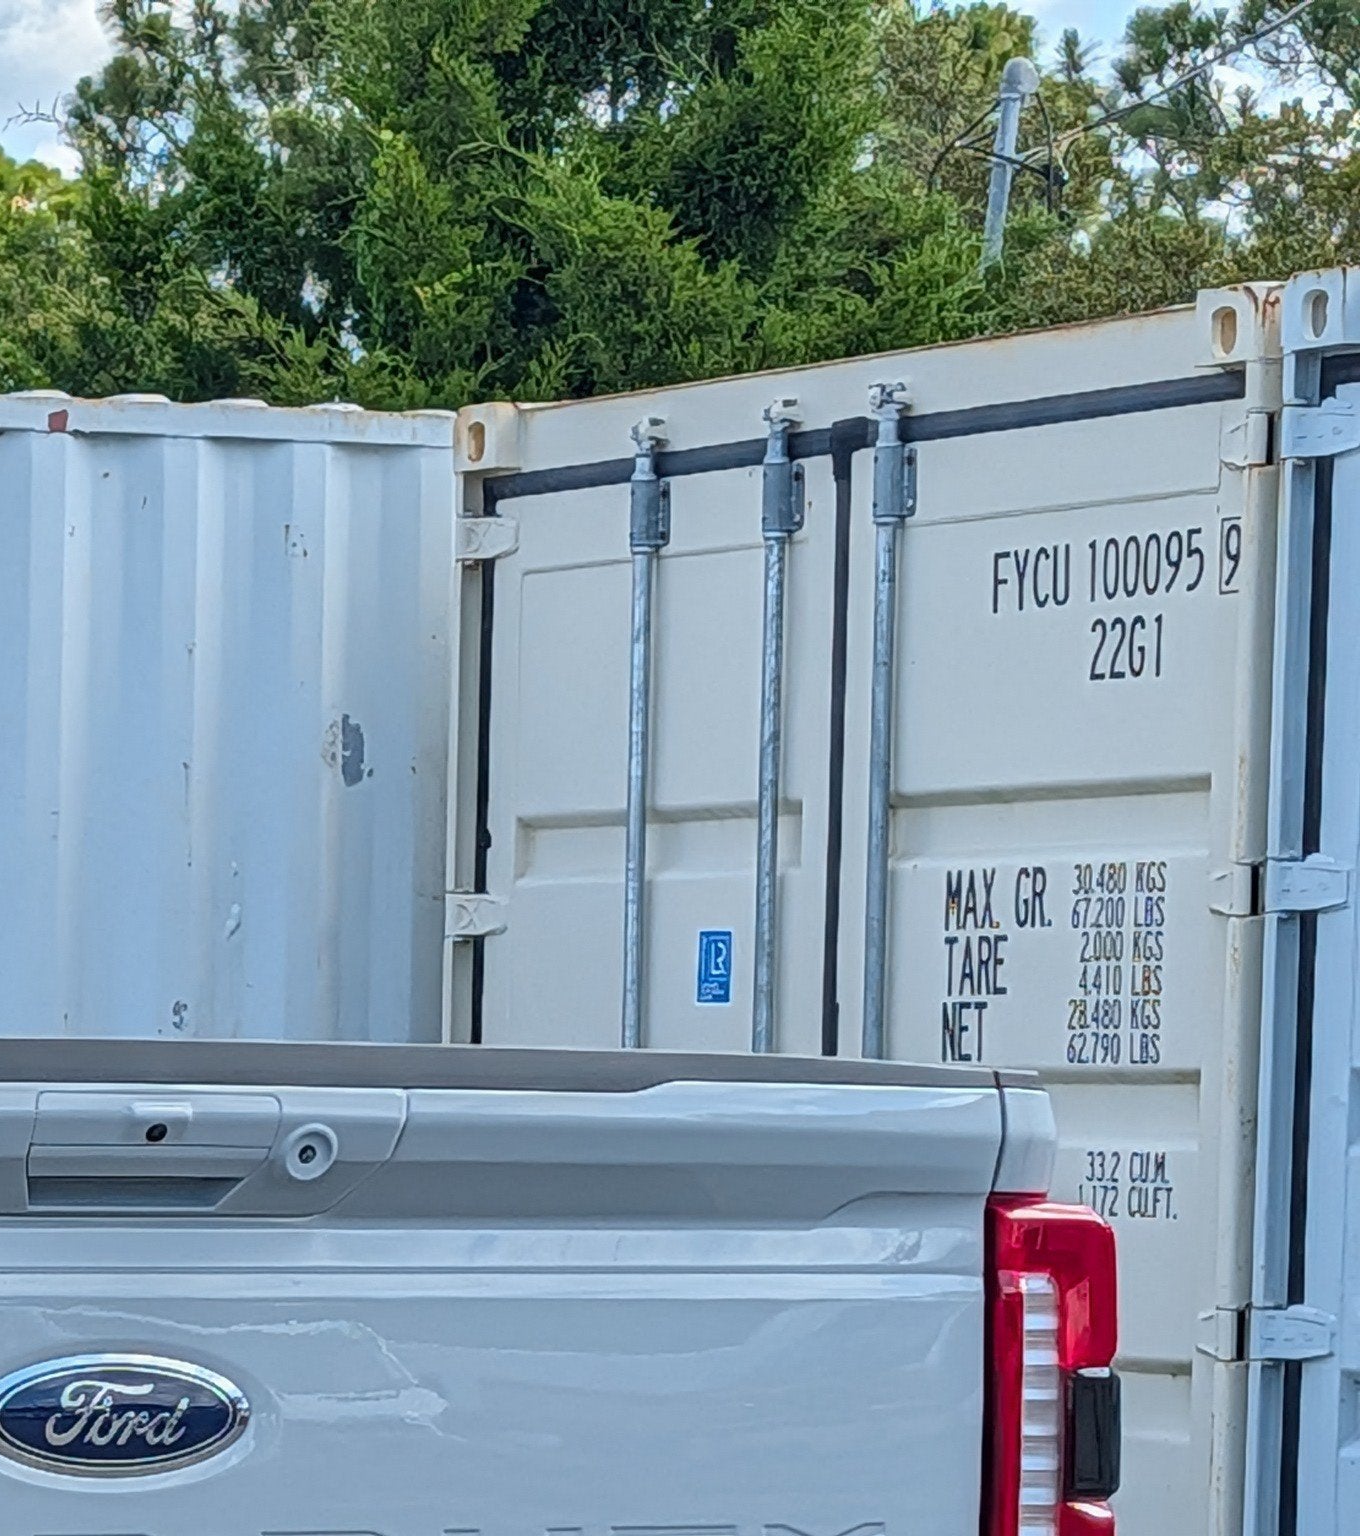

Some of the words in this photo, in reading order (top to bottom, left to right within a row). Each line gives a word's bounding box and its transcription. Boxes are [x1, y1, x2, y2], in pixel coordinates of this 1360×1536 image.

[992, 543, 1071, 614] FYCU
[1088, 527, 1205, 602] 100095
[1223, 522, 1242, 587] 9
[1089, 613, 1163, 681] 22G1
[1014, 866, 1053, 928] GR.
[1135, 861, 1167, 893] KGS
[1133, 896, 1166, 928] LBS
[944, 934, 1009, 997] TARE
[1132, 930, 1164, 962] KGS
[1131, 964, 1163, 996] LBS
[941, 1001, 988, 1063] NET
[1130, 999, 1161, 1030] KGS
[1129, 1032, 1161, 1065] LBS
[46, 1380, 190, 1446] Ford
